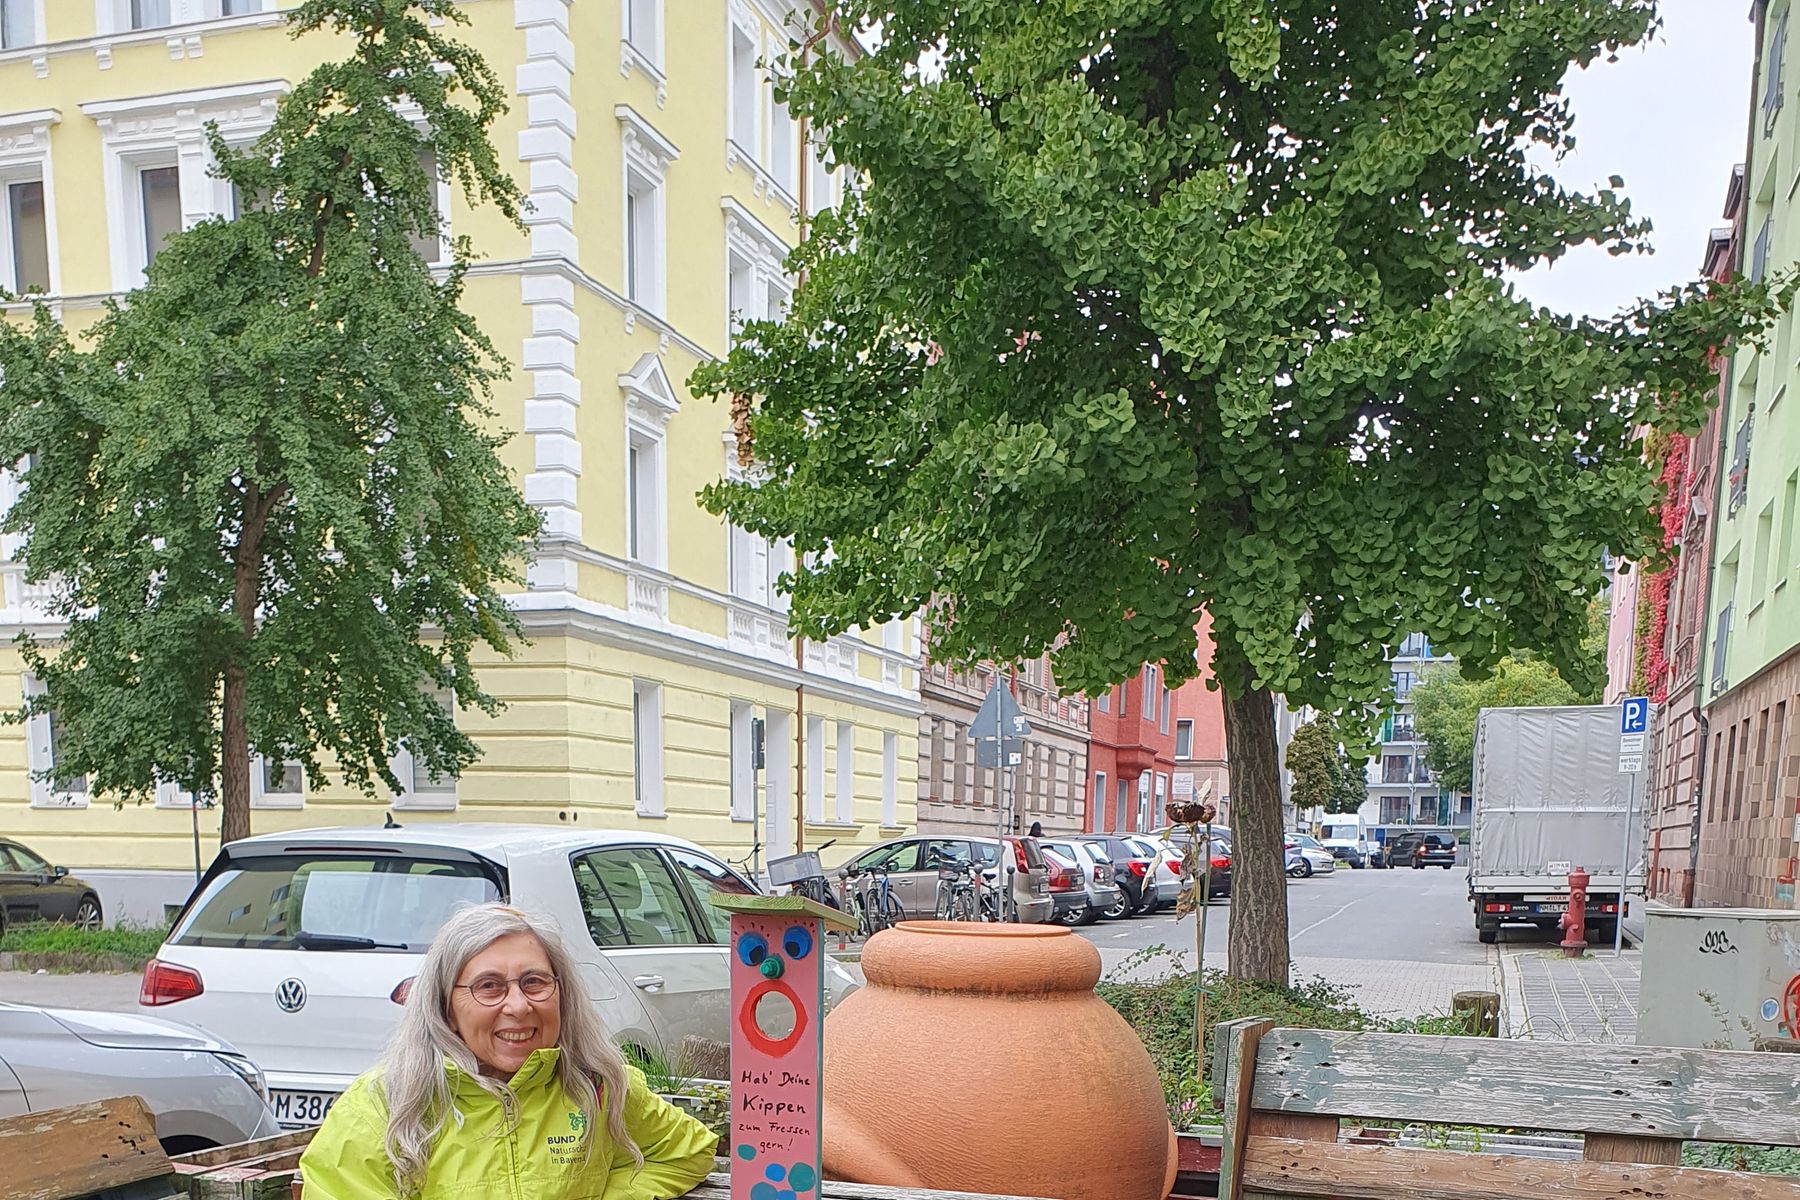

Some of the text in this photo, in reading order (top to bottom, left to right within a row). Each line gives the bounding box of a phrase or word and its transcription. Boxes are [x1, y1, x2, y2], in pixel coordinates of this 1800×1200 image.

[1625, 702, 1640, 729] P
[778, 1072, 810, 1087] Deine
[743, 1093, 806, 1116] Kippen
[739, 1122, 810, 1135] zum Fressen
[547, 1135, 576, 1145] BUND
